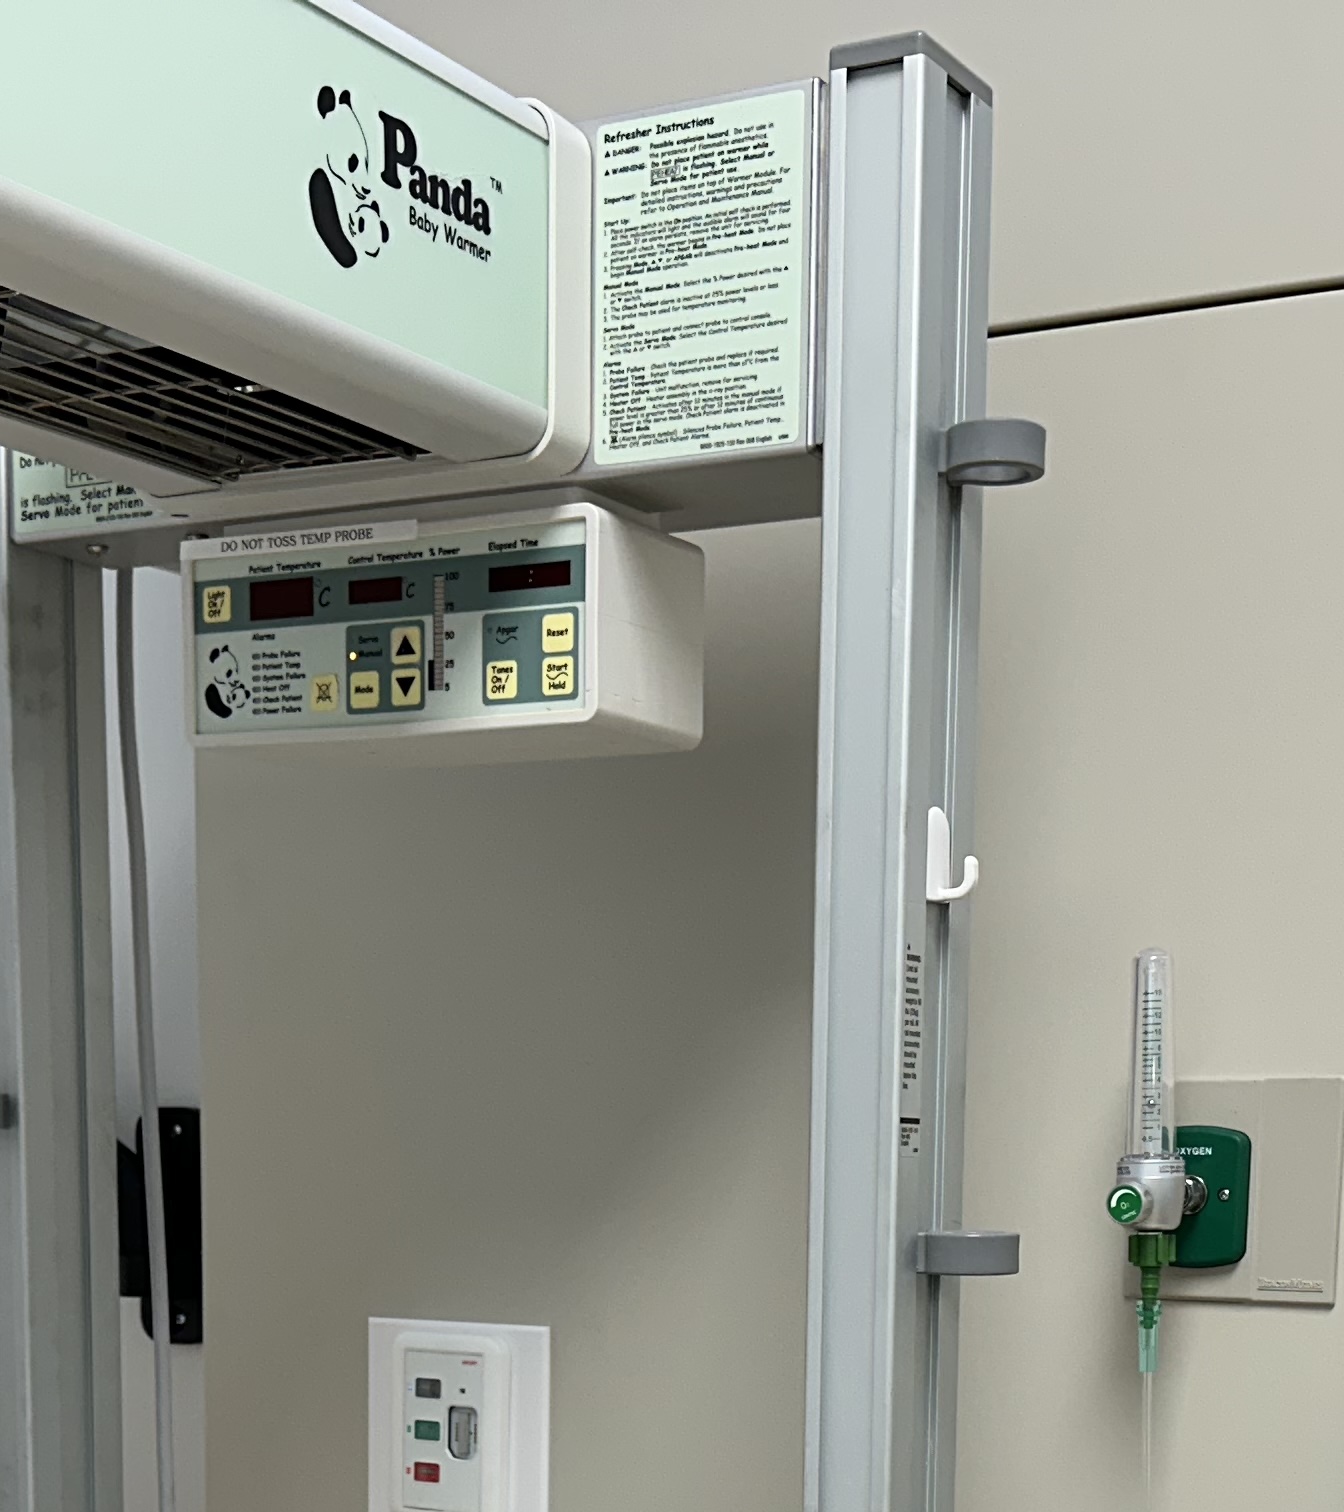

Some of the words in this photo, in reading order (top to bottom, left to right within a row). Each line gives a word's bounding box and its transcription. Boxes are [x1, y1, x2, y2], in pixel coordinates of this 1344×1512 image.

[604, 128, 652, 144] Refresher
[655, 116, 714, 135] Instructions
[378, 110, 492, 236] Panda
[489, 175, 504, 195] TM
[409, 205, 439, 242] Baby
[443, 222, 492, 263] Warmer
[19, 456, 32, 469] Do
[20, 497, 29, 508] is
[80, 487, 112, 501] Select
[20, 510, 50, 522] Servo
[54, 505, 82, 518] Mode
[86, 501, 103, 514] for
[107, 498, 144, 515] patien
[221, 540, 238, 553] DO
[241, 537, 264, 551] NOT
[267, 535, 297, 549] TOSS
[300, 532, 332, 546] TEMP
[335, 527, 374, 543] PROBE
[488, 539, 518, 553] Elapsed
[520, 538, 539, 549] Time
[438, 547, 461, 556] Power
[347, 555, 374, 565] Control
[376, 549, 424, 564] Temperature
[248, 564, 273, 575] Patient
[276, 560, 322, 573] Temperature
[445, 572, 460, 581] 100
[252, 633, 276, 641] Alarms
[445, 631, 455, 640] 50
[546, 628, 569, 638] Reset
[491, 665, 514, 674] Tones
[546, 663, 569, 672] Start
[491, 676, 502, 684] On
[354, 685, 374, 695] Mode
[491, 685, 506, 694] Off
[548, 681, 567, 690] Hold
